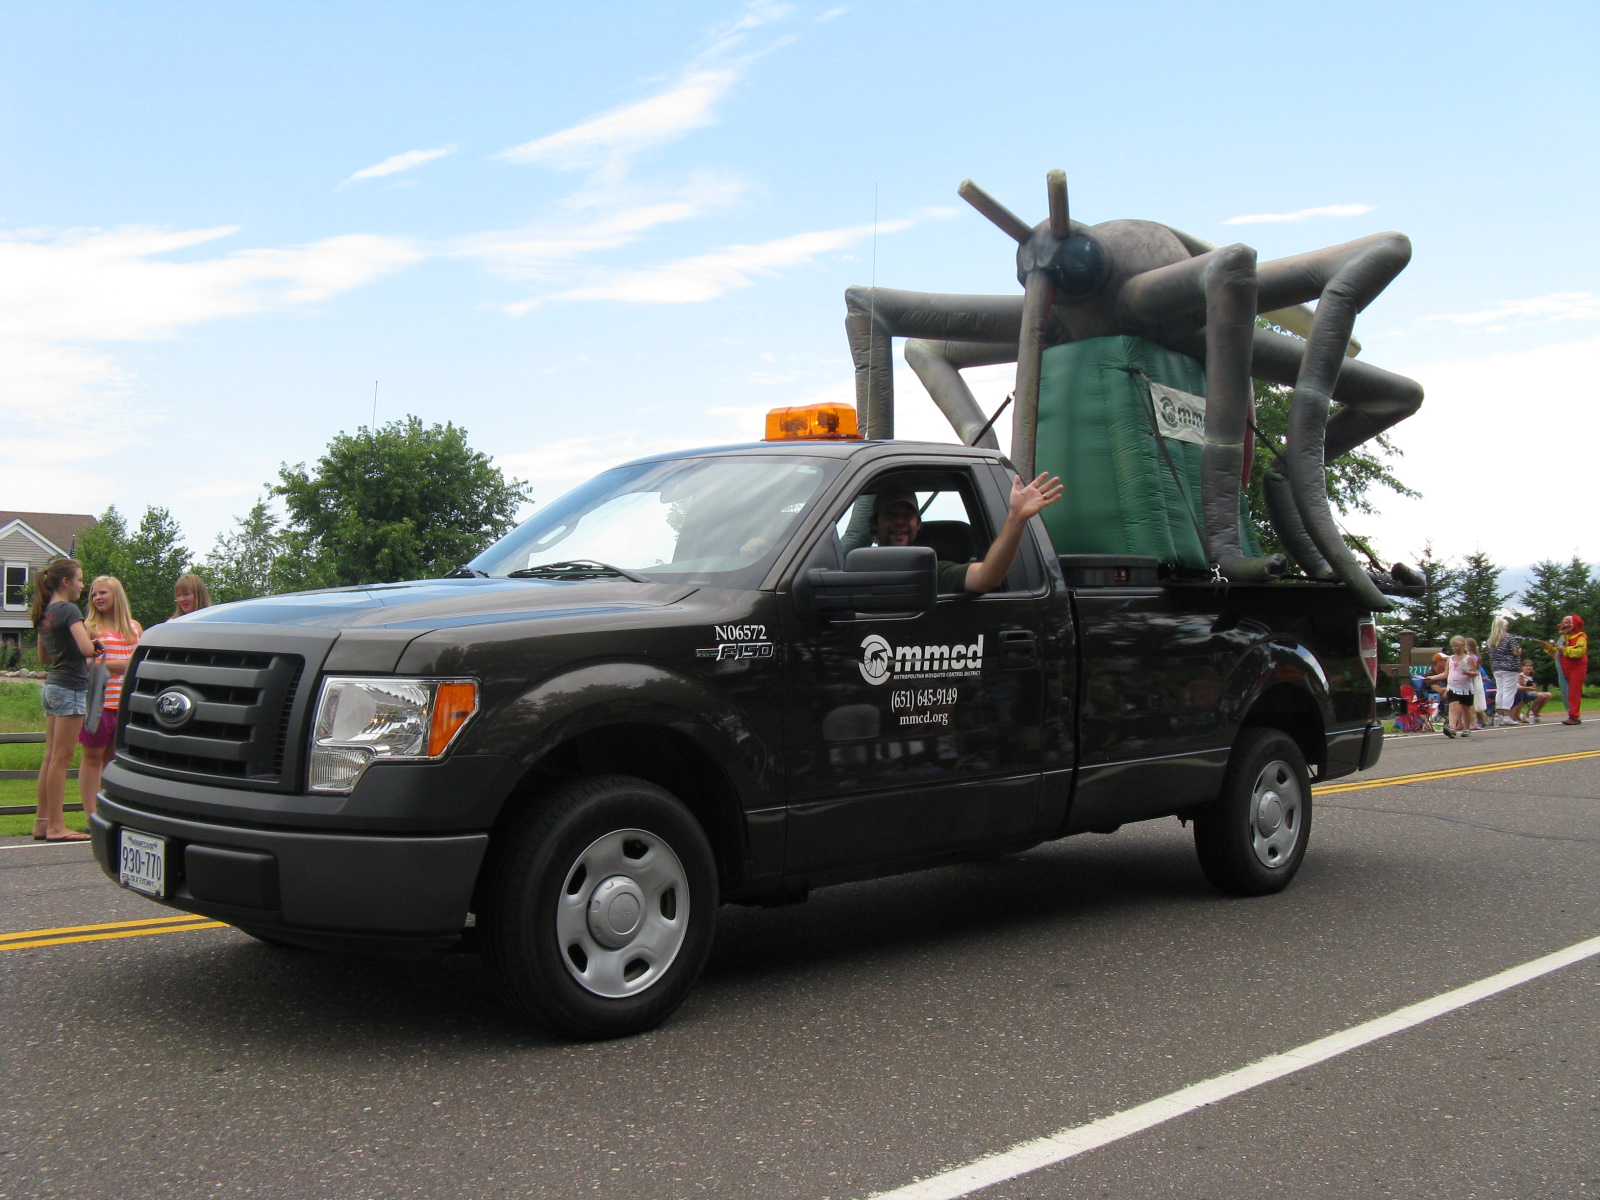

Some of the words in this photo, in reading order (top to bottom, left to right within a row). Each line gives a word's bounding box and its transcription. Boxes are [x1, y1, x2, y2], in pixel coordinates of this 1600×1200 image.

[714, 625, 767, 640] N06572
[894, 634, 984, 672] mmcd
[893, 672, 925, 680] METROPOLITAN
[925, 671, 946, 679] MOSQUITO
[891, 689, 915, 712] (651)
[917, 687, 958, 707] 645-9149
[899, 711, 949, 725] mmcd.org
[122, 846, 162, 881] 930-770
